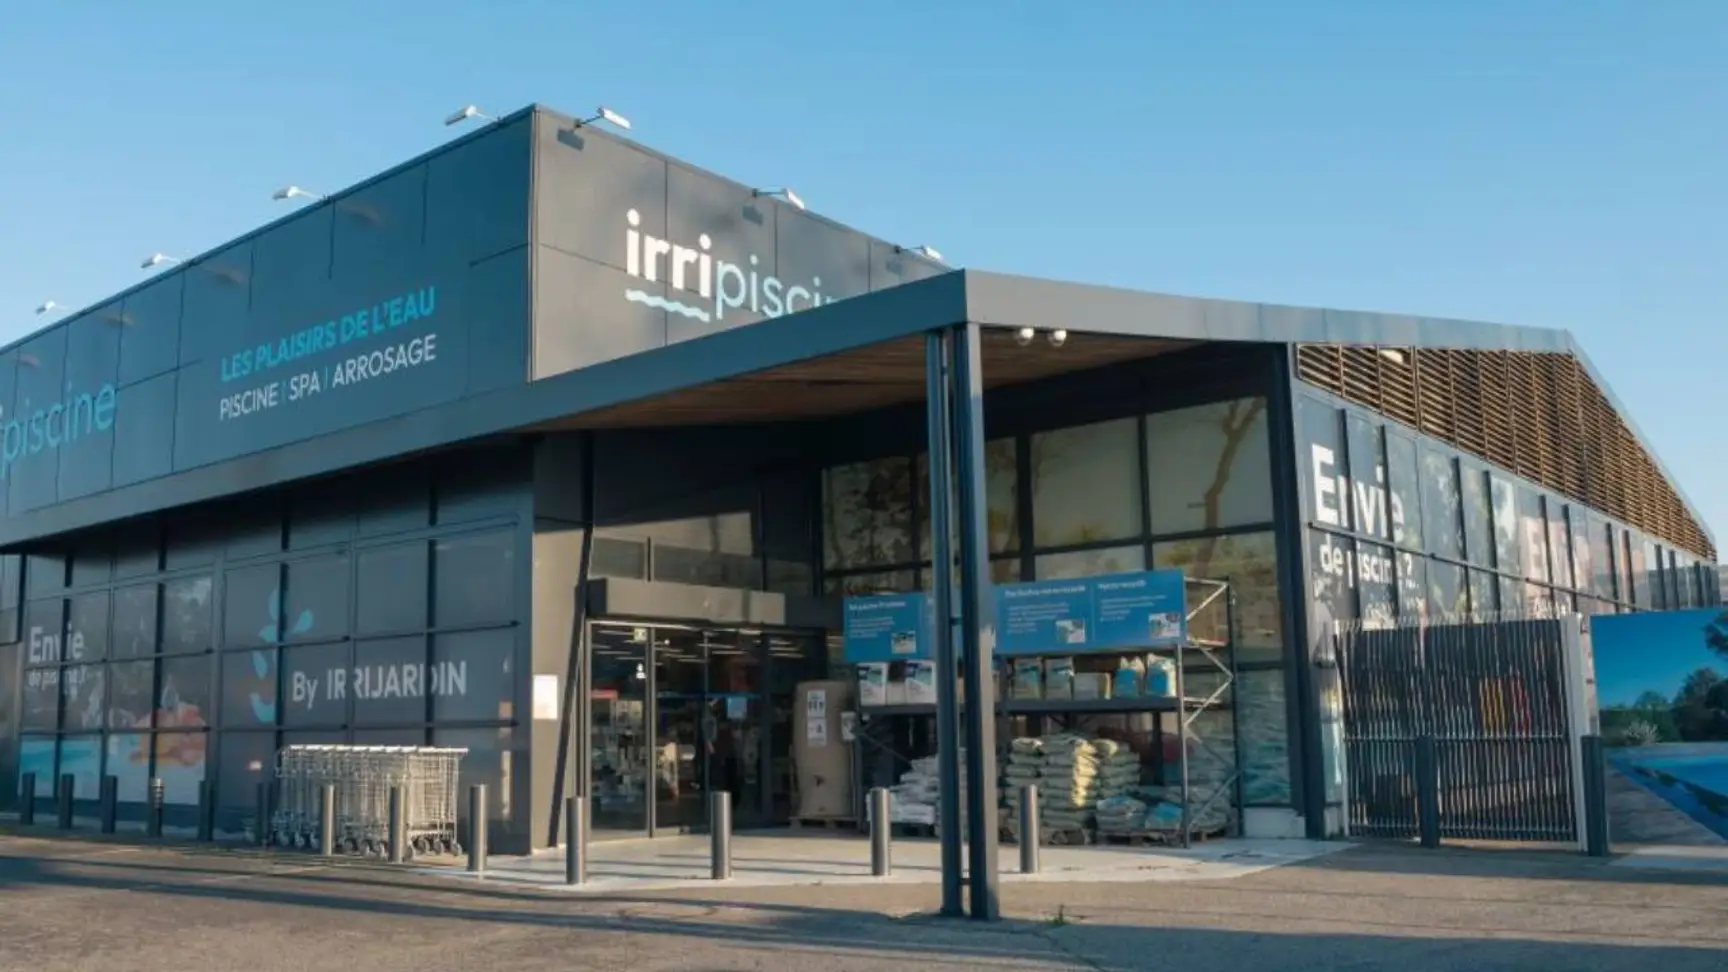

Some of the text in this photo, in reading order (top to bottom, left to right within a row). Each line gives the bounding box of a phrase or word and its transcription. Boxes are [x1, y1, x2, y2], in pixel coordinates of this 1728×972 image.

[221, 286, 436, 382] LES PLAISIRS DE L'EAU
[219, 334, 438, 421] PISCINE SPA ARROSAGE
[1320, 532, 1344, 577] de
[292, 660, 468, 709] By IRRIJARDIN
